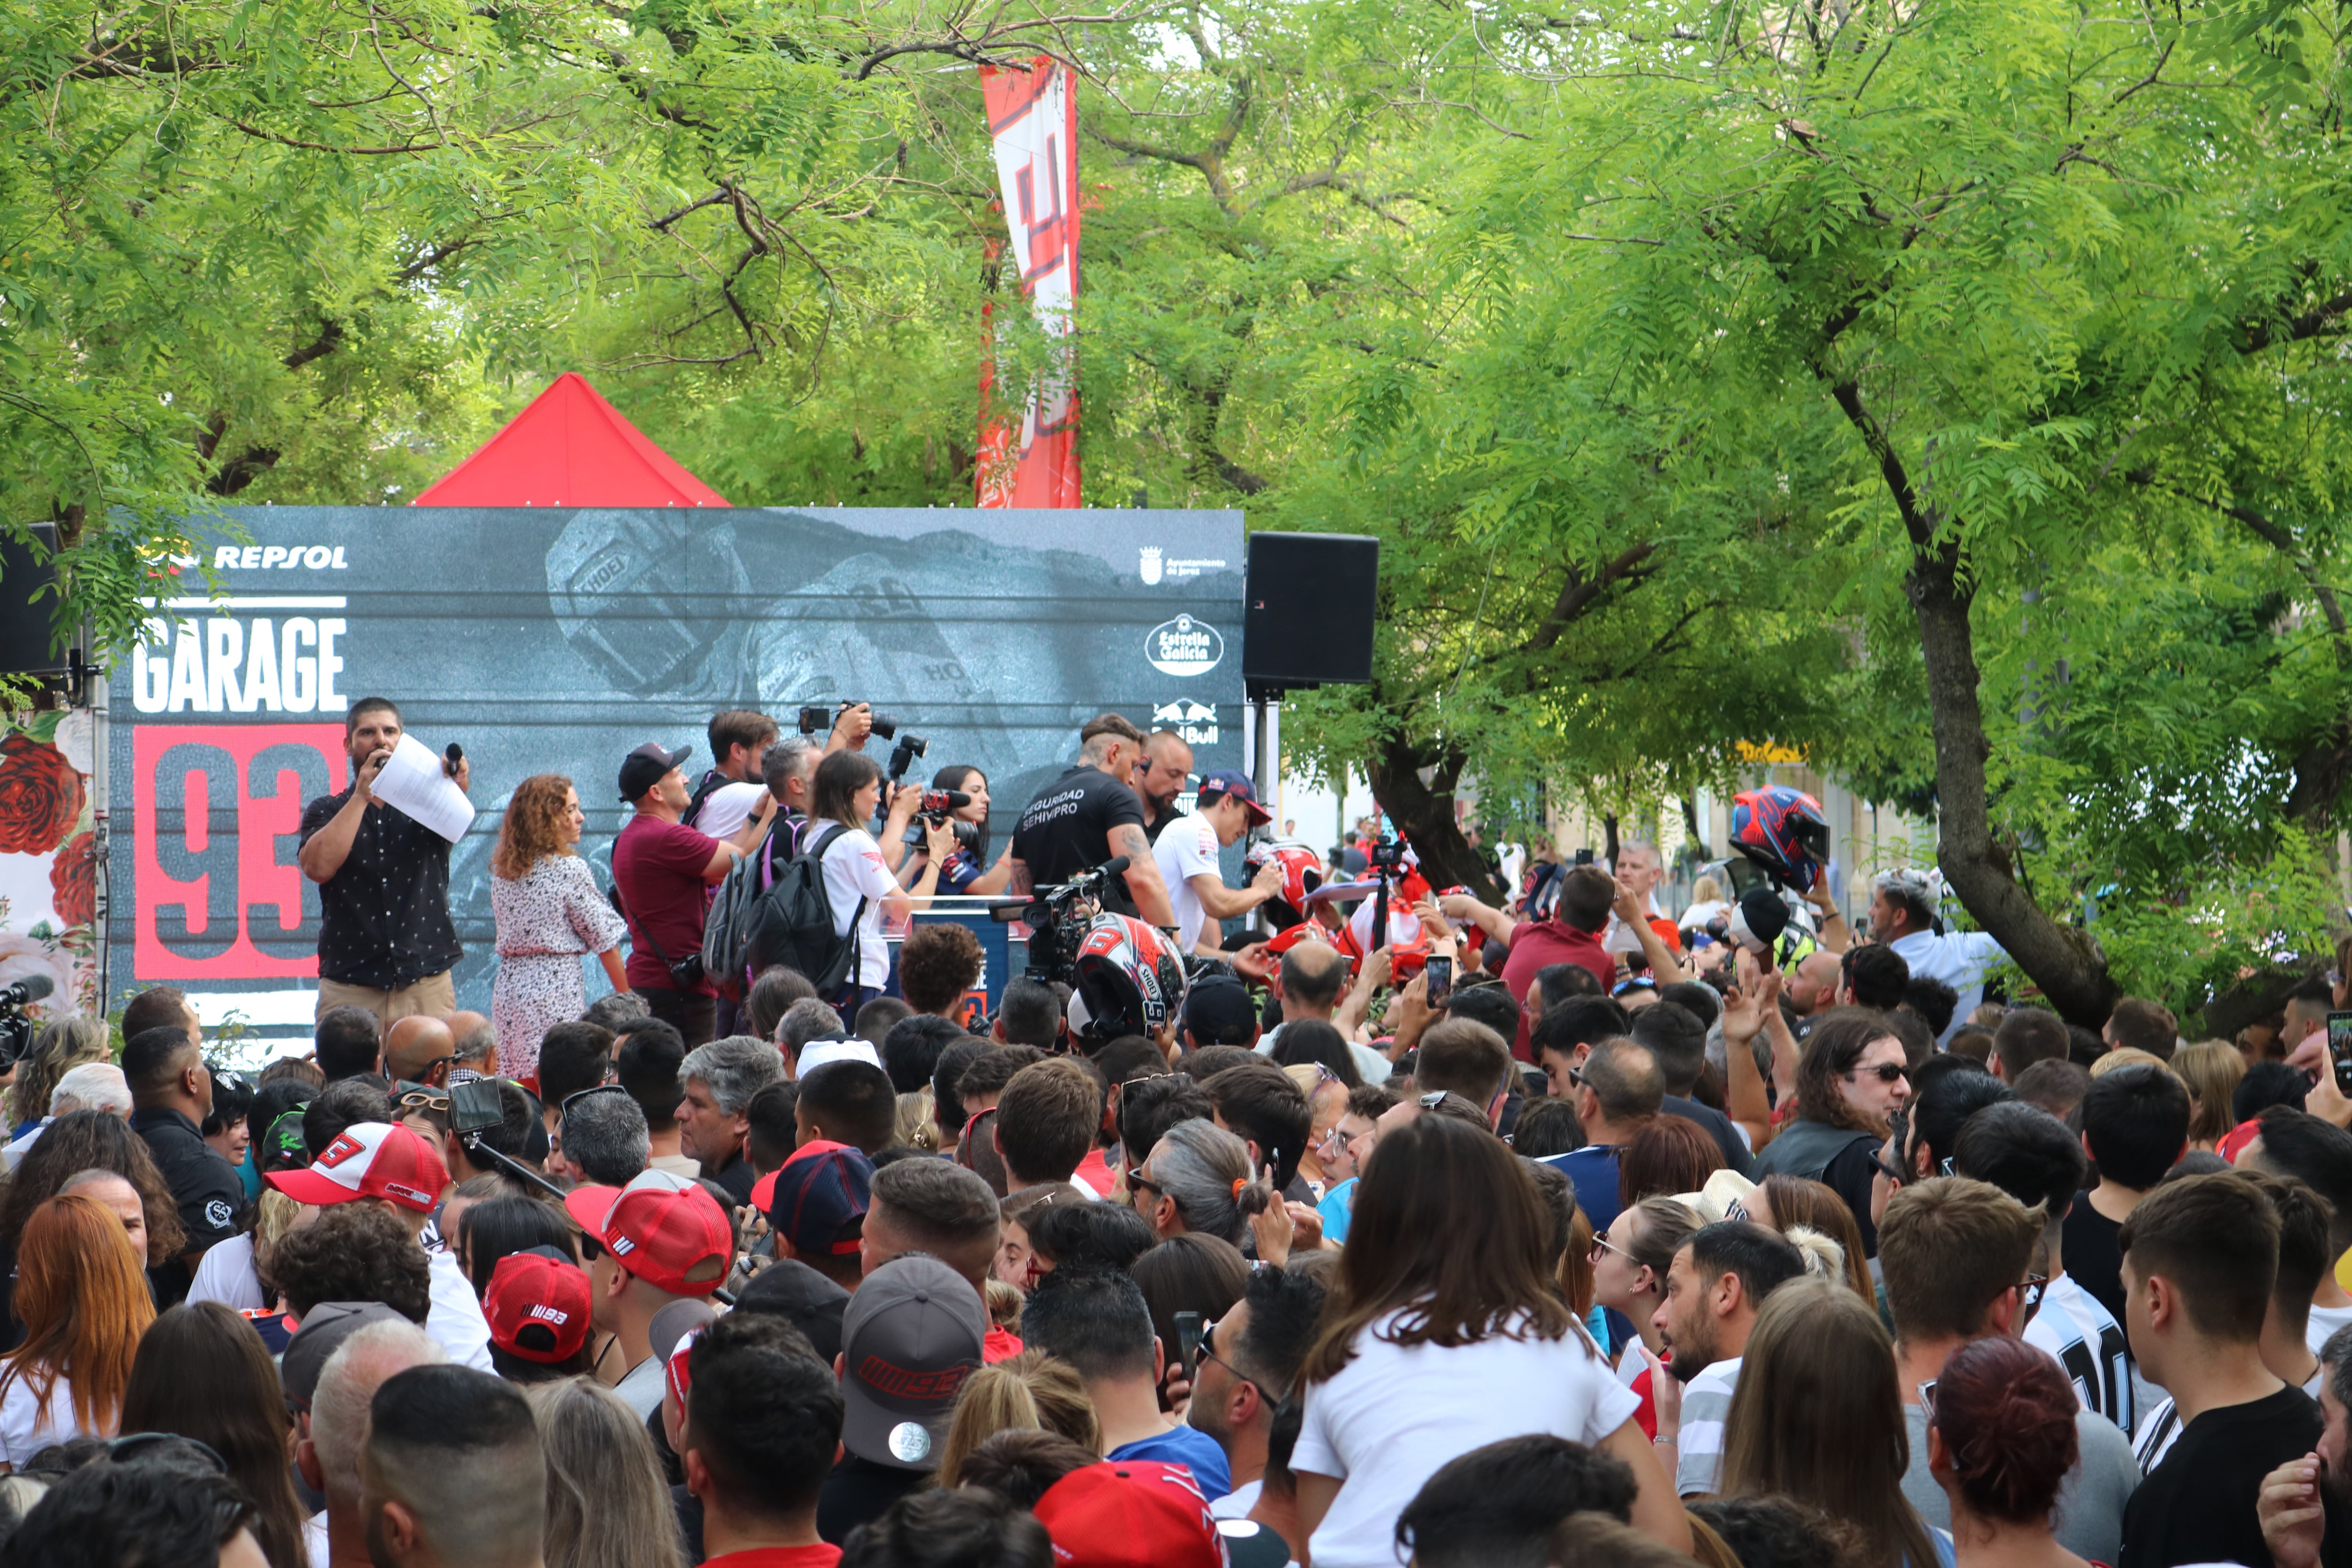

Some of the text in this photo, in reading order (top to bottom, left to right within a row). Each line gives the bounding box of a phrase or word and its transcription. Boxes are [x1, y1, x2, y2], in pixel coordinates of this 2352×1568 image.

[214, 545, 348, 569] REPSOL
[1166, 558, 1226, 567] Ayuntamiento
[1166, 566, 1200, 577] de Jerez
[1159, 631, 1210, 646] Estrella
[1160, 645, 1208, 661] Galicia
[133, 617, 348, 714] GARAGE
[1185, 725, 1218, 745] Bull
[1023, 788, 1085, 820] SEGURIDAD
[154, 742, 331, 961] 93
[1141, 968, 1158, 995] SHOEI
[542, 1307, 568, 1325] 93
